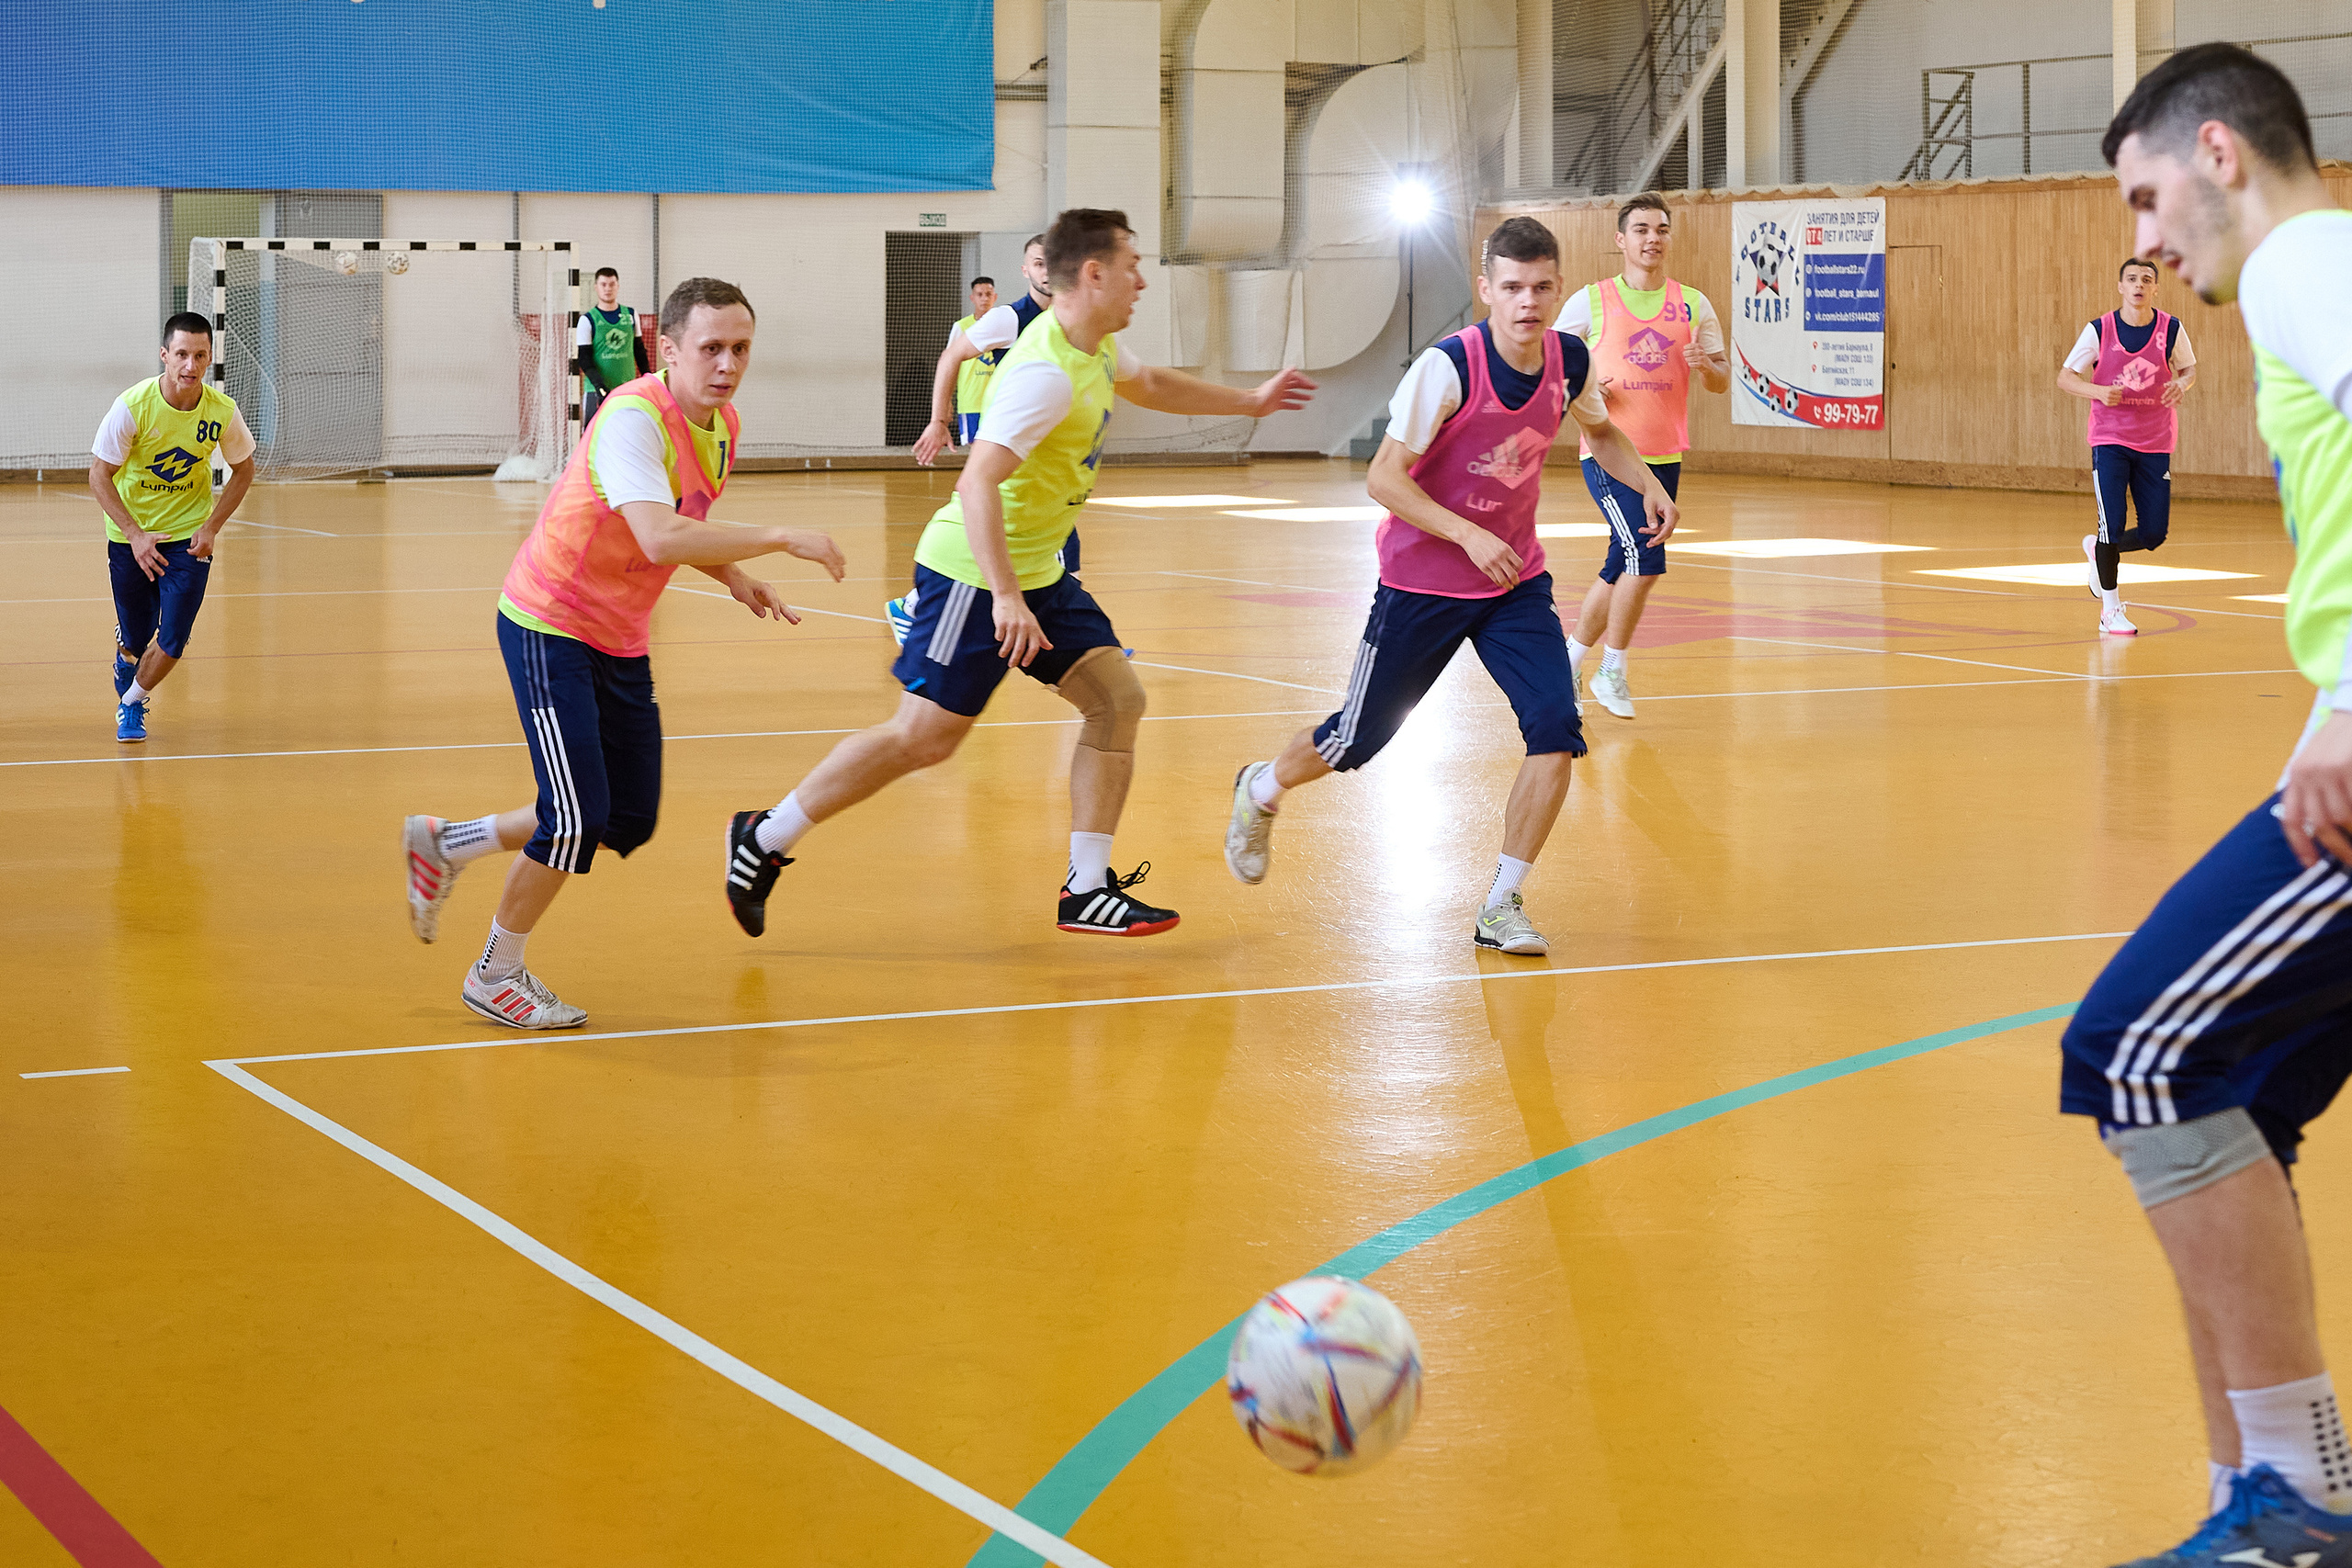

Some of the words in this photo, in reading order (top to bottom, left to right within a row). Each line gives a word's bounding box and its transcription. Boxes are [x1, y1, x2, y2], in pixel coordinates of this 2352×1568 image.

[1807, 212, 1838, 225] ЗАНЯТИЯ
[1840, 212, 1855, 226] ДЛЯ
[1857, 209, 1879, 226] ДЕТЕЙ
[1824, 230, 1837, 242] ЛЕТ
[1838, 230, 1844, 242] И
[1845, 230, 1874, 242] СТАРШЕ
[1664, 301, 1691, 322] 99
[1745, 297, 1790, 323] STARS
[2155, 332, 2166, 350] 8
[1628, 351, 1668, 365] adidas
[1623, 378, 1673, 392] Lumpini
[1824, 402, 1879, 424] 99-79-77
[197, 420, 221, 443] 80
[141, 479, 194, 493] Lumpini
